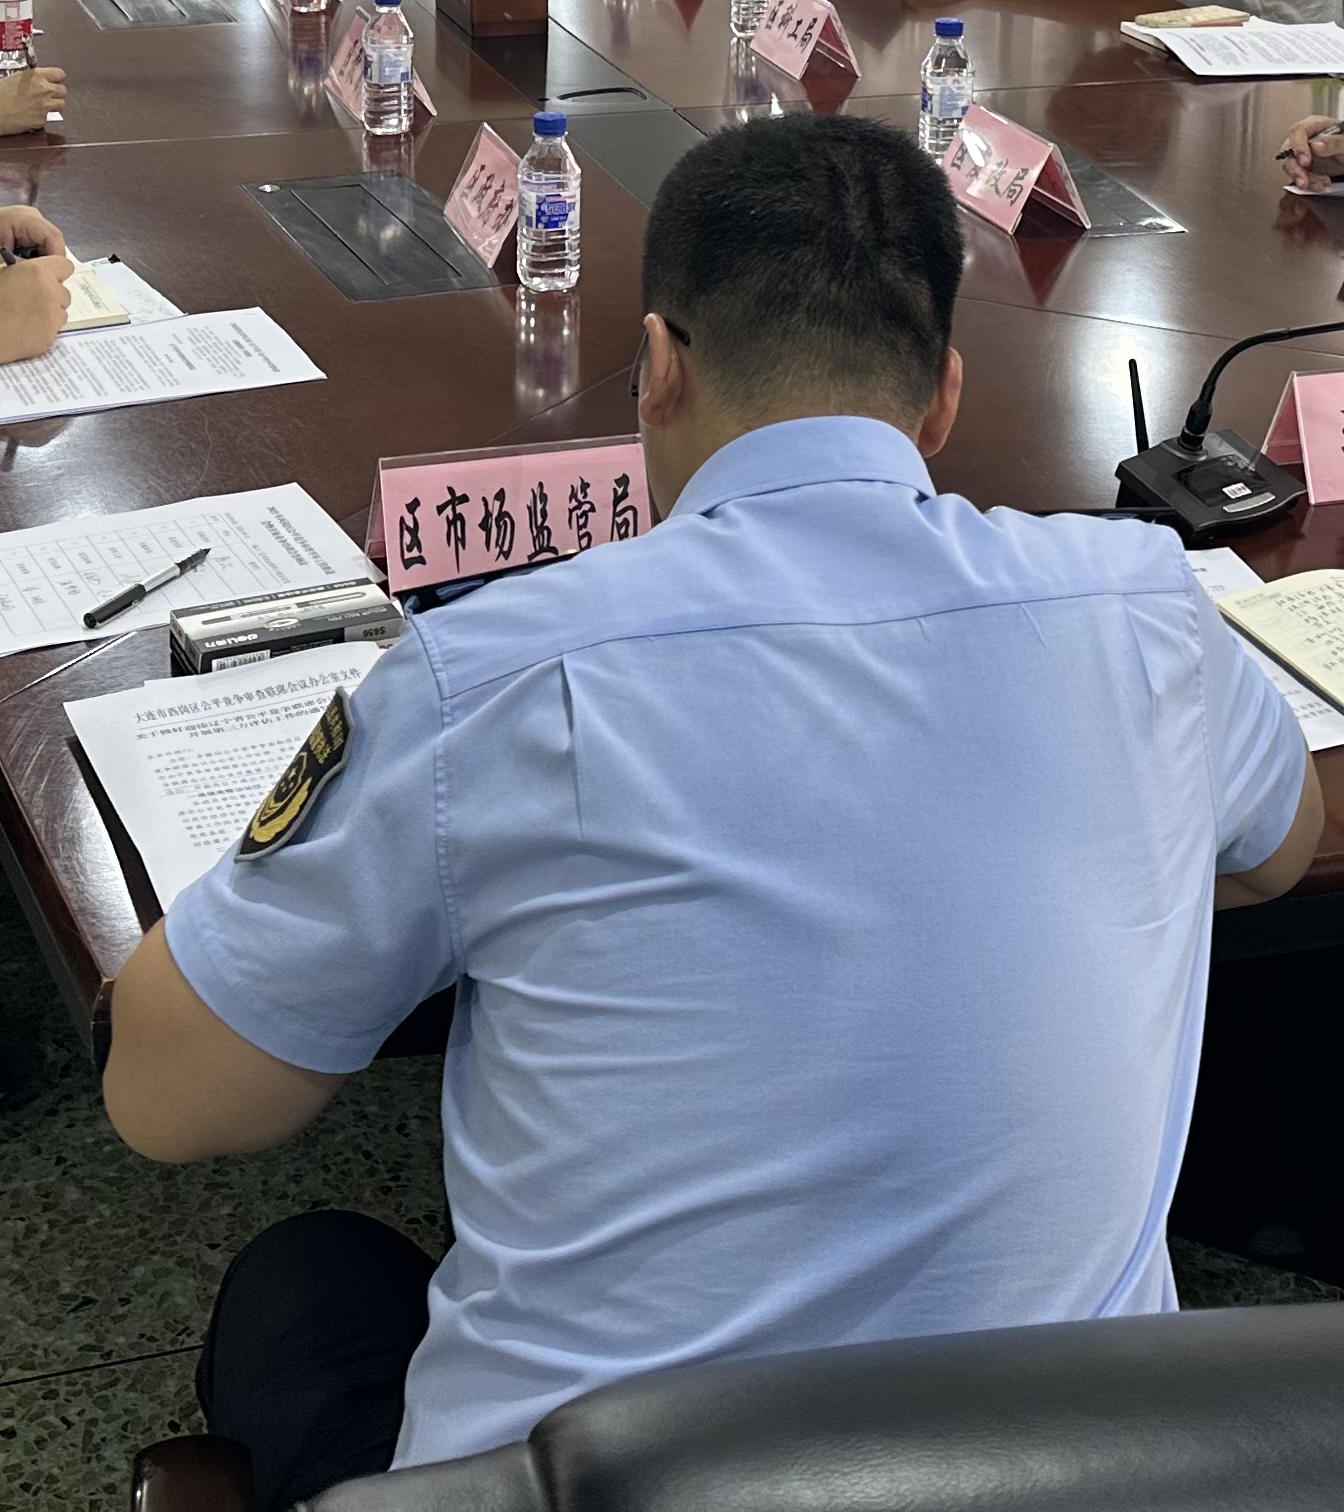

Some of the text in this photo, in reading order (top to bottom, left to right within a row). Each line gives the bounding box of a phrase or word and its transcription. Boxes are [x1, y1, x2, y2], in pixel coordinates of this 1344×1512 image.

[765, 0, 818, 54] 区科工局
[399, 473, 639, 573] 区市场监管局
